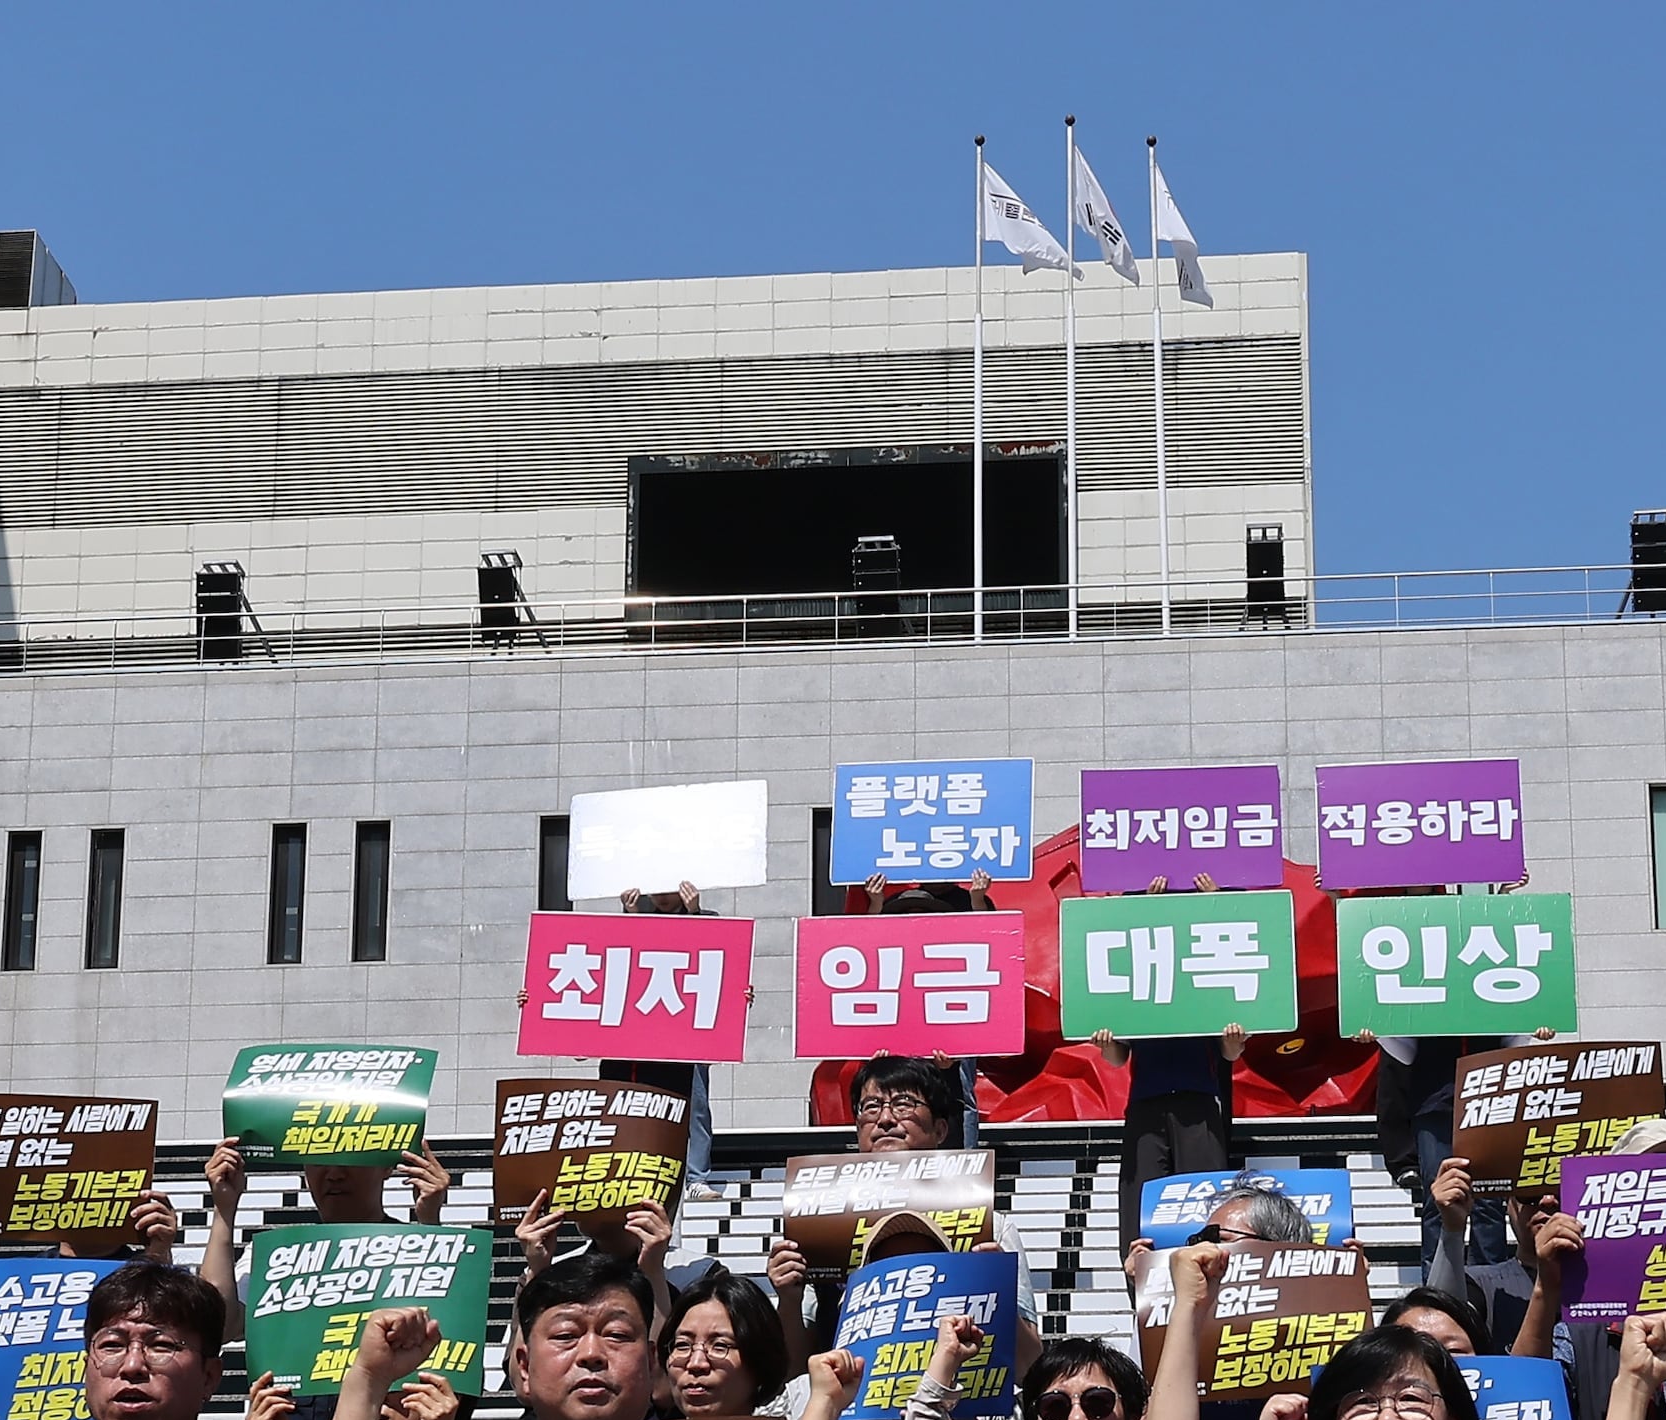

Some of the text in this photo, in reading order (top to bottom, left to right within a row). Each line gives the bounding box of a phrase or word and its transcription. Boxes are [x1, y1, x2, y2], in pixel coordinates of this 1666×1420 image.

[845, 773, 988, 818] 플랫폼
[1085, 804, 1279, 851] 최저임금
[1320, 797, 1520, 846] 적용하라
[875, 825, 1021, 869] 노동자
[819, 943, 1001, 1026] 임금
[1085, 921, 1270, 1004] 대폭
[1361, 923, 1553, 1004] 인상
[542, 943, 724, 1030] 최저
[246, 1051, 307, 1074] 영세
[1459, 1044, 1656, 1099] 모든 일하는 사람에게
[62, 1102, 152, 1133] 사람에게
[499, 1088, 687, 1125] 모든 일하는 사람에게
[1458, 1086, 1582, 1130] 차별 없는
[14, 1136, 74, 1167] 없는
[498, 1118, 617, 1156] 차별 없는
[13, 1168, 147, 1201] 노동기본권
[555, 1150, 682, 1185] 노동기본권
[5, 1199, 131, 1231] 보장하라!!
[264, 1238, 331, 1281] 영세
[252, 1265, 456, 1318] 소상공인 지원
